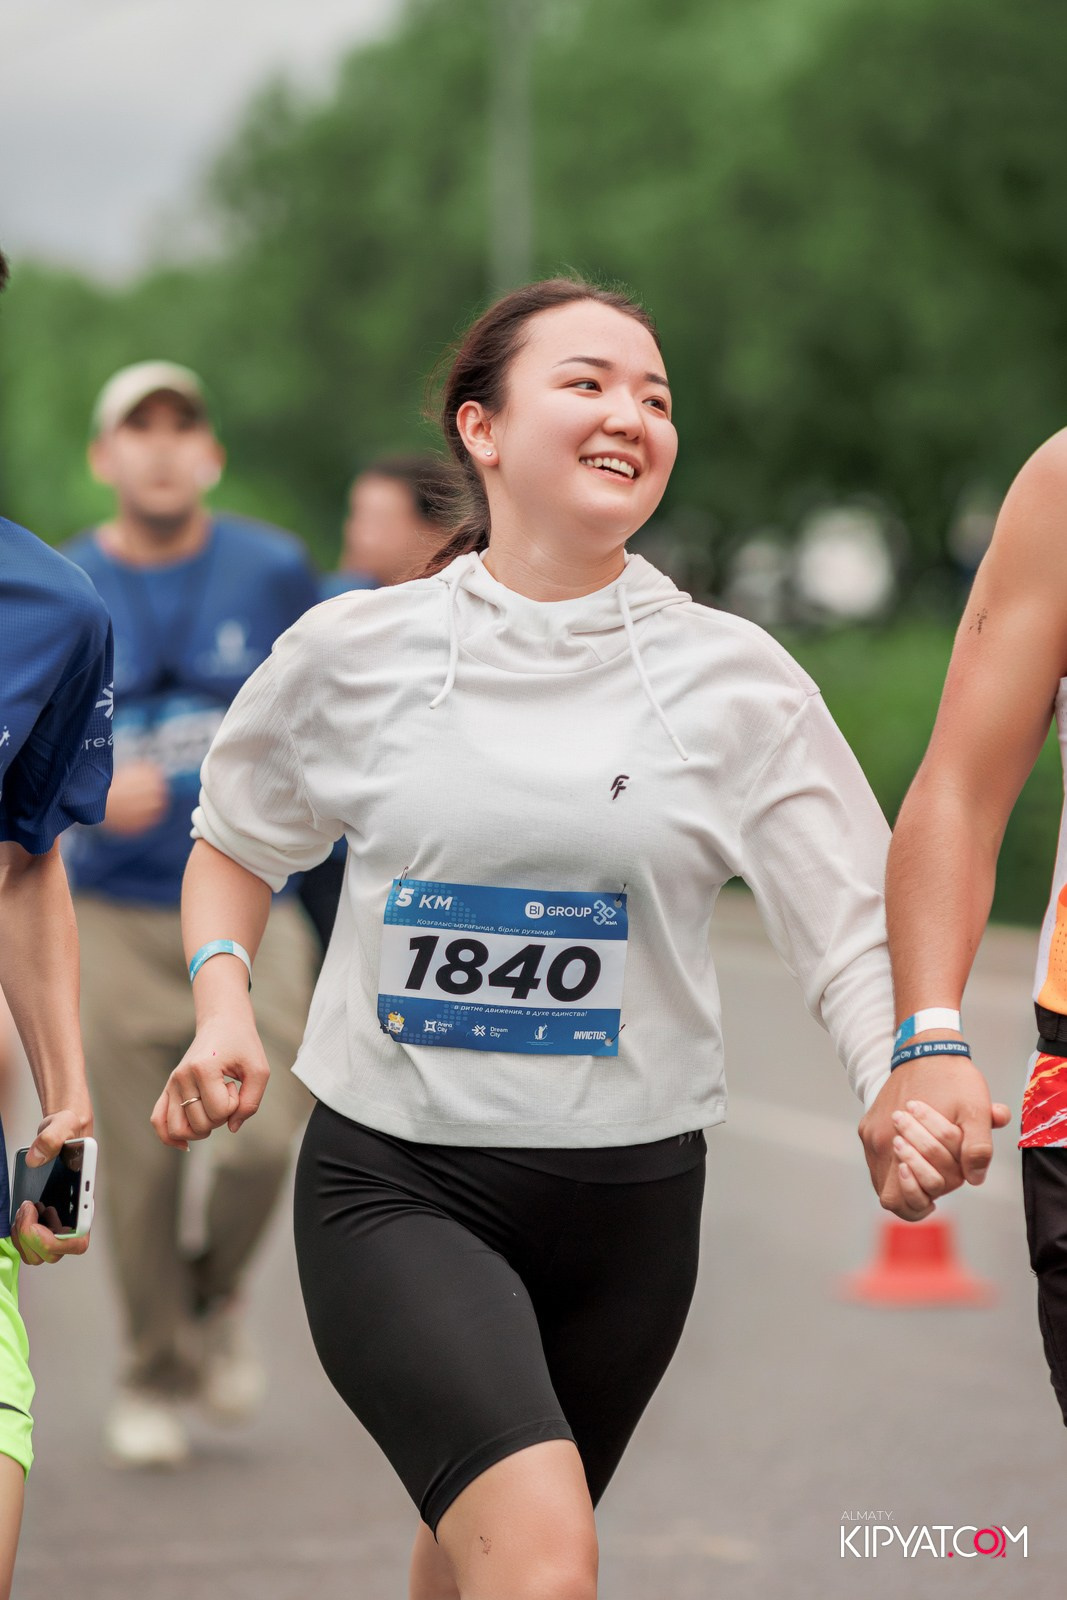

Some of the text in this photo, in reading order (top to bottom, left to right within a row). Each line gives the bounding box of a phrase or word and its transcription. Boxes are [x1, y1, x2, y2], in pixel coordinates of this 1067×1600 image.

[395, 887, 453, 911] 5 KM
[546, 906, 592, 918] GROUP
[404, 934, 602, 1002] 1840
[460, 1005, 484, 1013] ритме
[484, 1007, 524, 1016] движения,
[551, 1010, 588, 1018] единства!
[437, 1026, 448, 1034] City
[489, 1031, 501, 1039] City
[490, 1026, 509, 1034] Dream
[573, 1030, 607, 1041] INVICTUS
